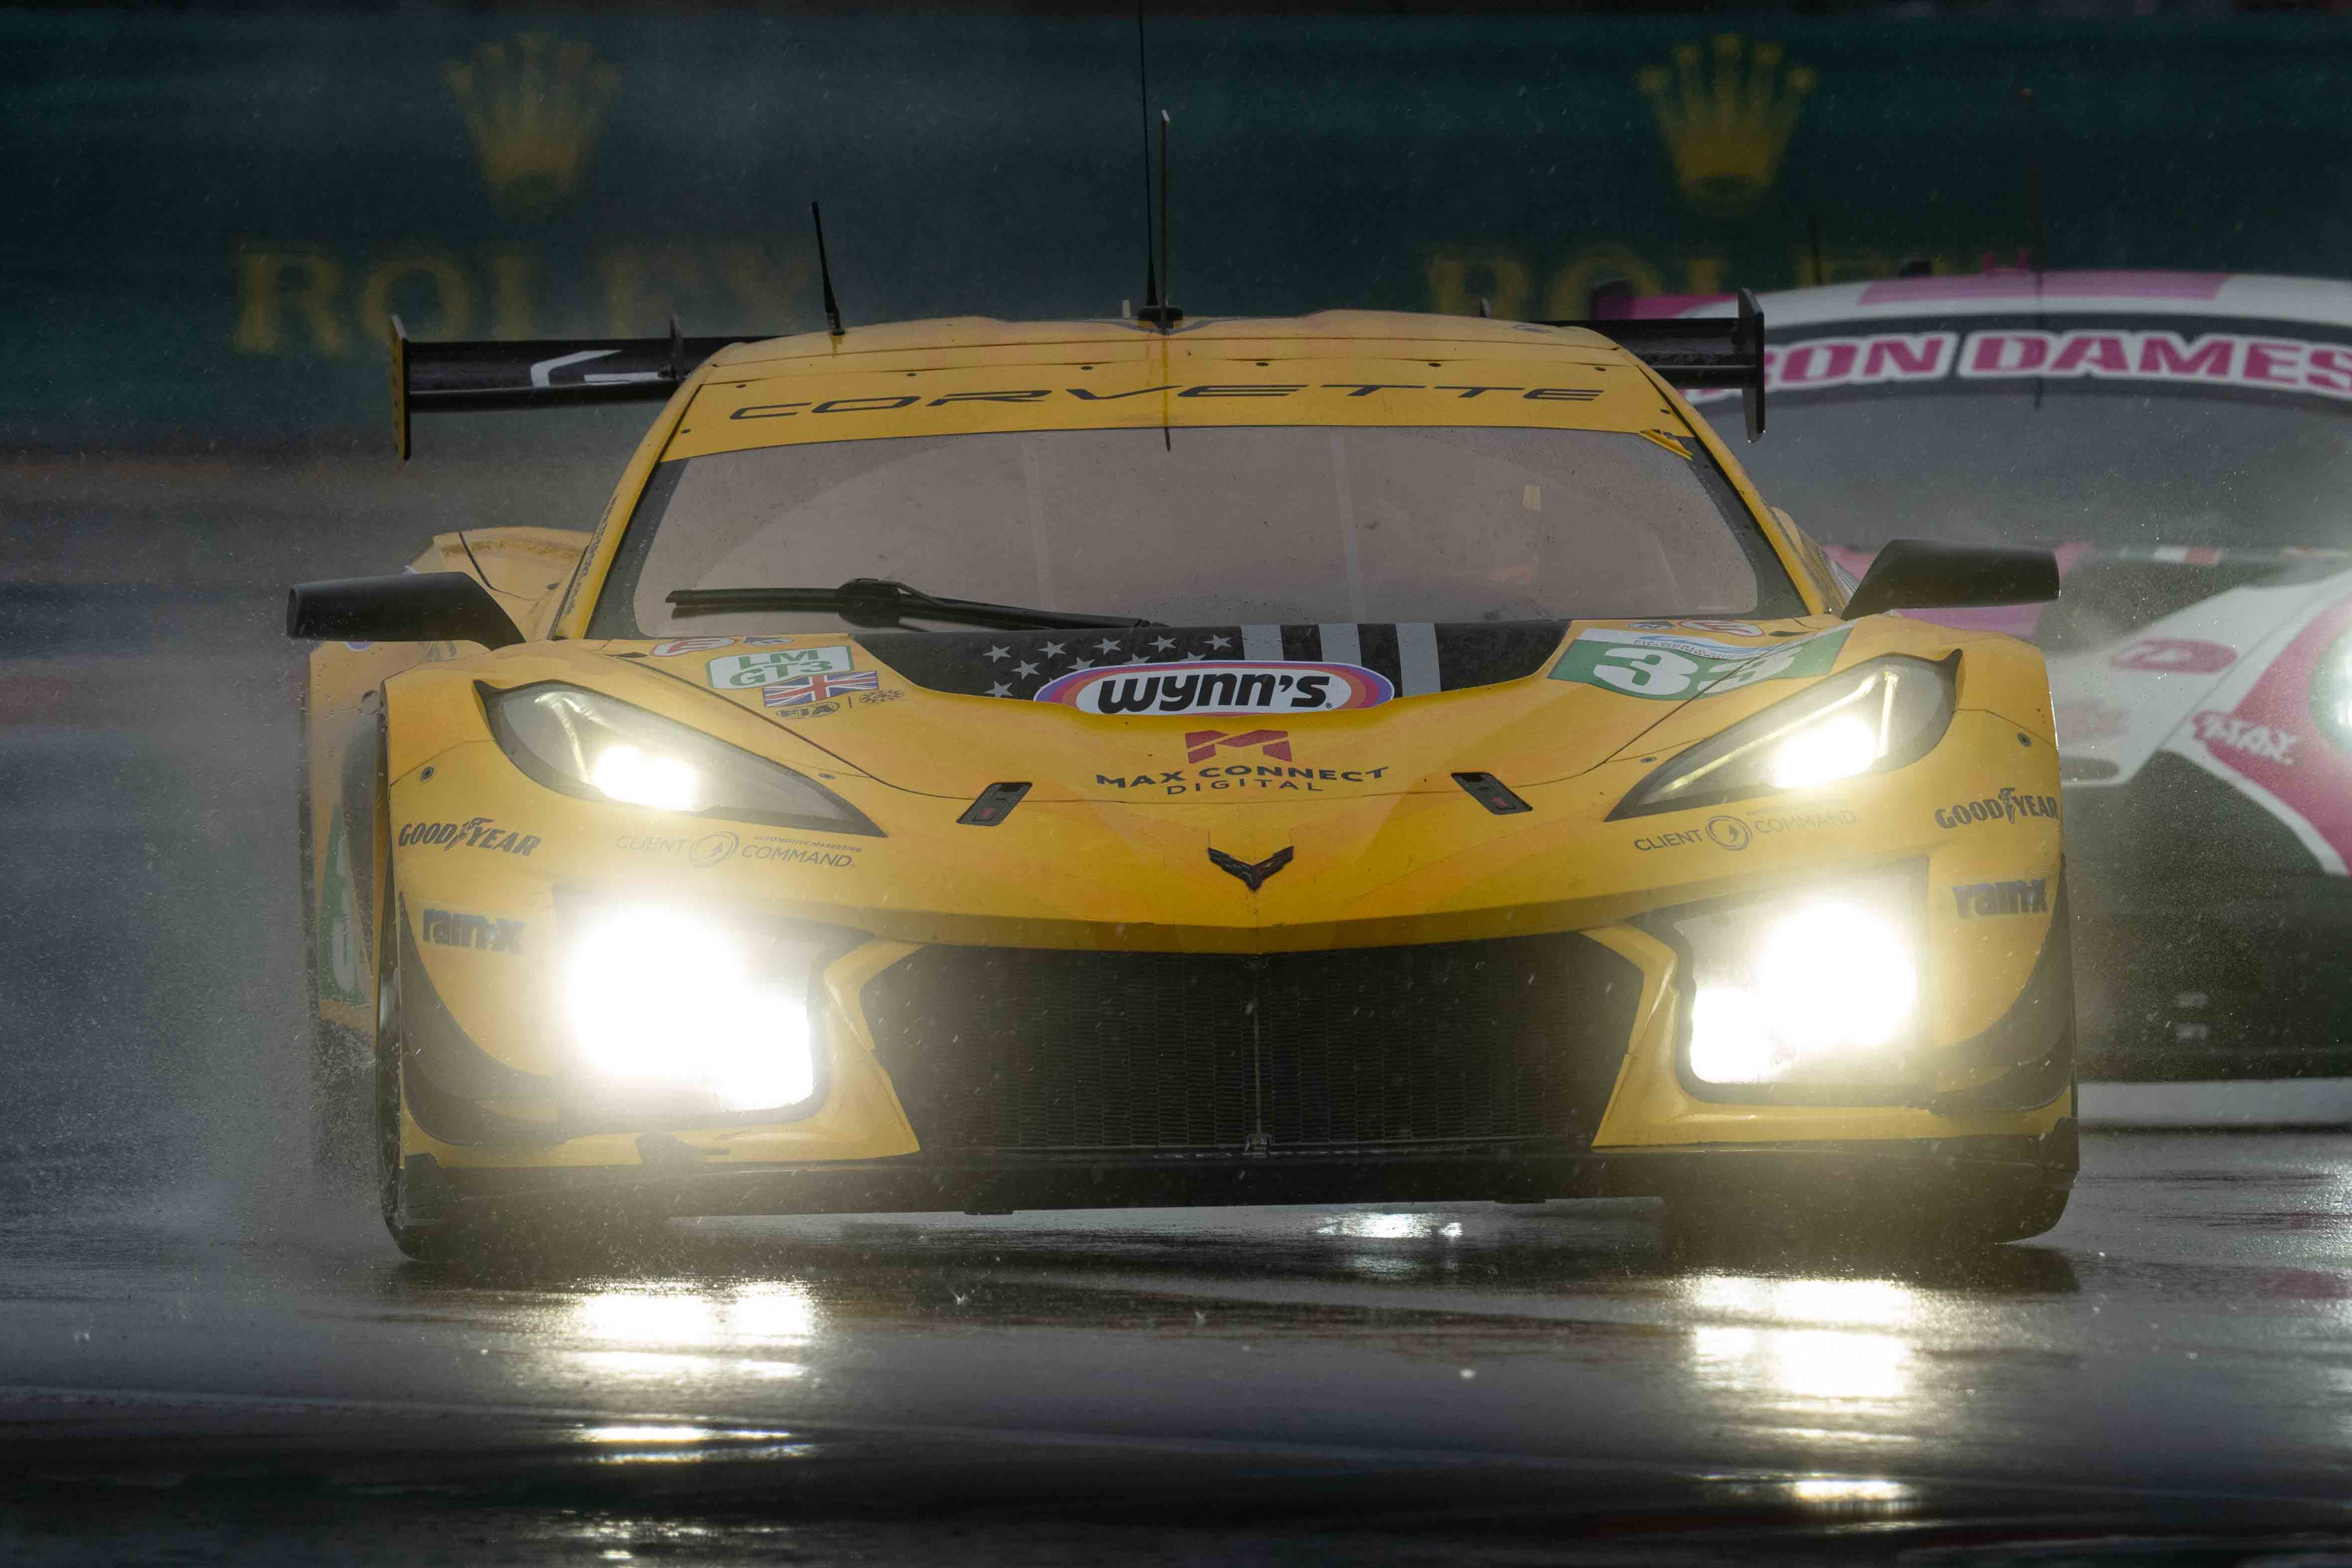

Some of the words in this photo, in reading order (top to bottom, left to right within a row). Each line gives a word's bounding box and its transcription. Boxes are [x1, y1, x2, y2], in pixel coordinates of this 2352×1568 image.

[1972, 337, 2352, 391] DAMES
[729, 384, 1604, 420] CORVETTE
[739, 649, 820, 669] LM
[729, 660, 834, 686] GT3
[1097, 771, 1186, 788] MAX
[1199, 765, 1389, 781] CONNECT
[1167, 779, 1324, 795] DIGITAL
[1634, 829, 1703, 851] CLIENT
[1755, 810, 1857, 834] COMMAND
[616, 834, 688, 853] CLIENT
[741, 845, 853, 867] COMMAND
[810, 841, 862, 853] MARKETING
